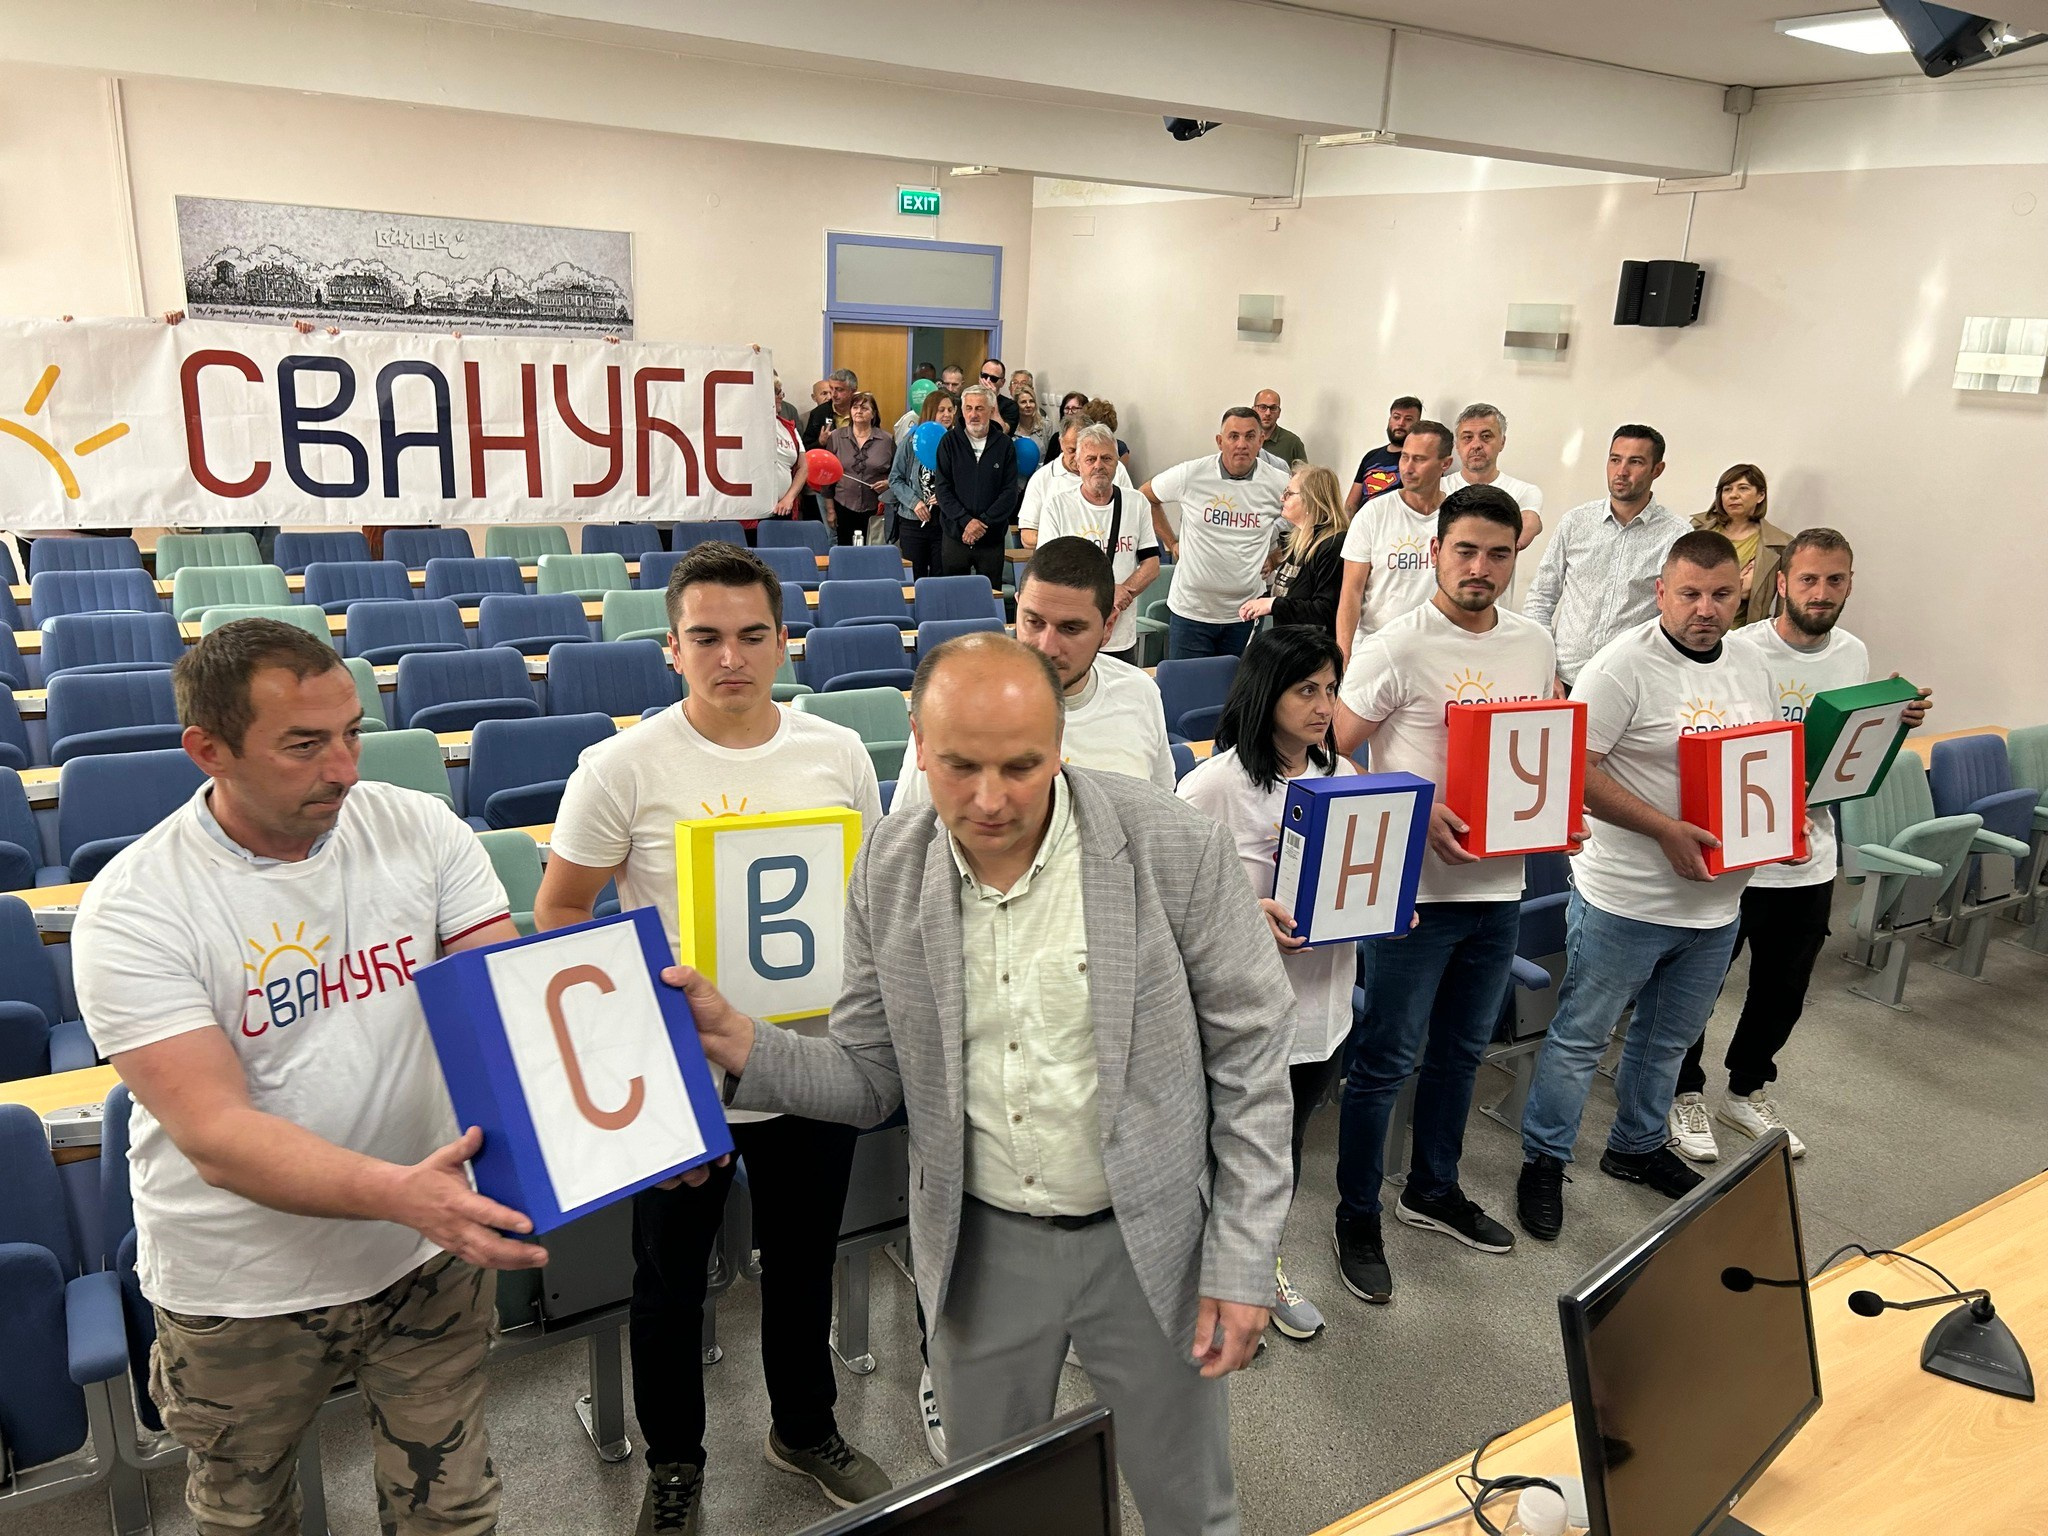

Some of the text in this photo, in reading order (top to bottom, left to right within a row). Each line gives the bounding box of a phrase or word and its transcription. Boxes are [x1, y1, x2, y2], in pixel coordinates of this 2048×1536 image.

[903, 195, 938, 212] EXIT
[180, 349, 754, 499] СВАНУЋЕ
[1204, 507, 1261, 528] СВАНУЋЕ
[1387, 552, 1437, 570] СВАН
[1509, 728, 1550, 821] У
[1834, 718, 1885, 782] Е
[1335, 811, 1390, 910] Н
[747, 855, 815, 981] В
[242, 935, 417, 1038] СВАНУЋЕ
[546, 964, 646, 1131] С
